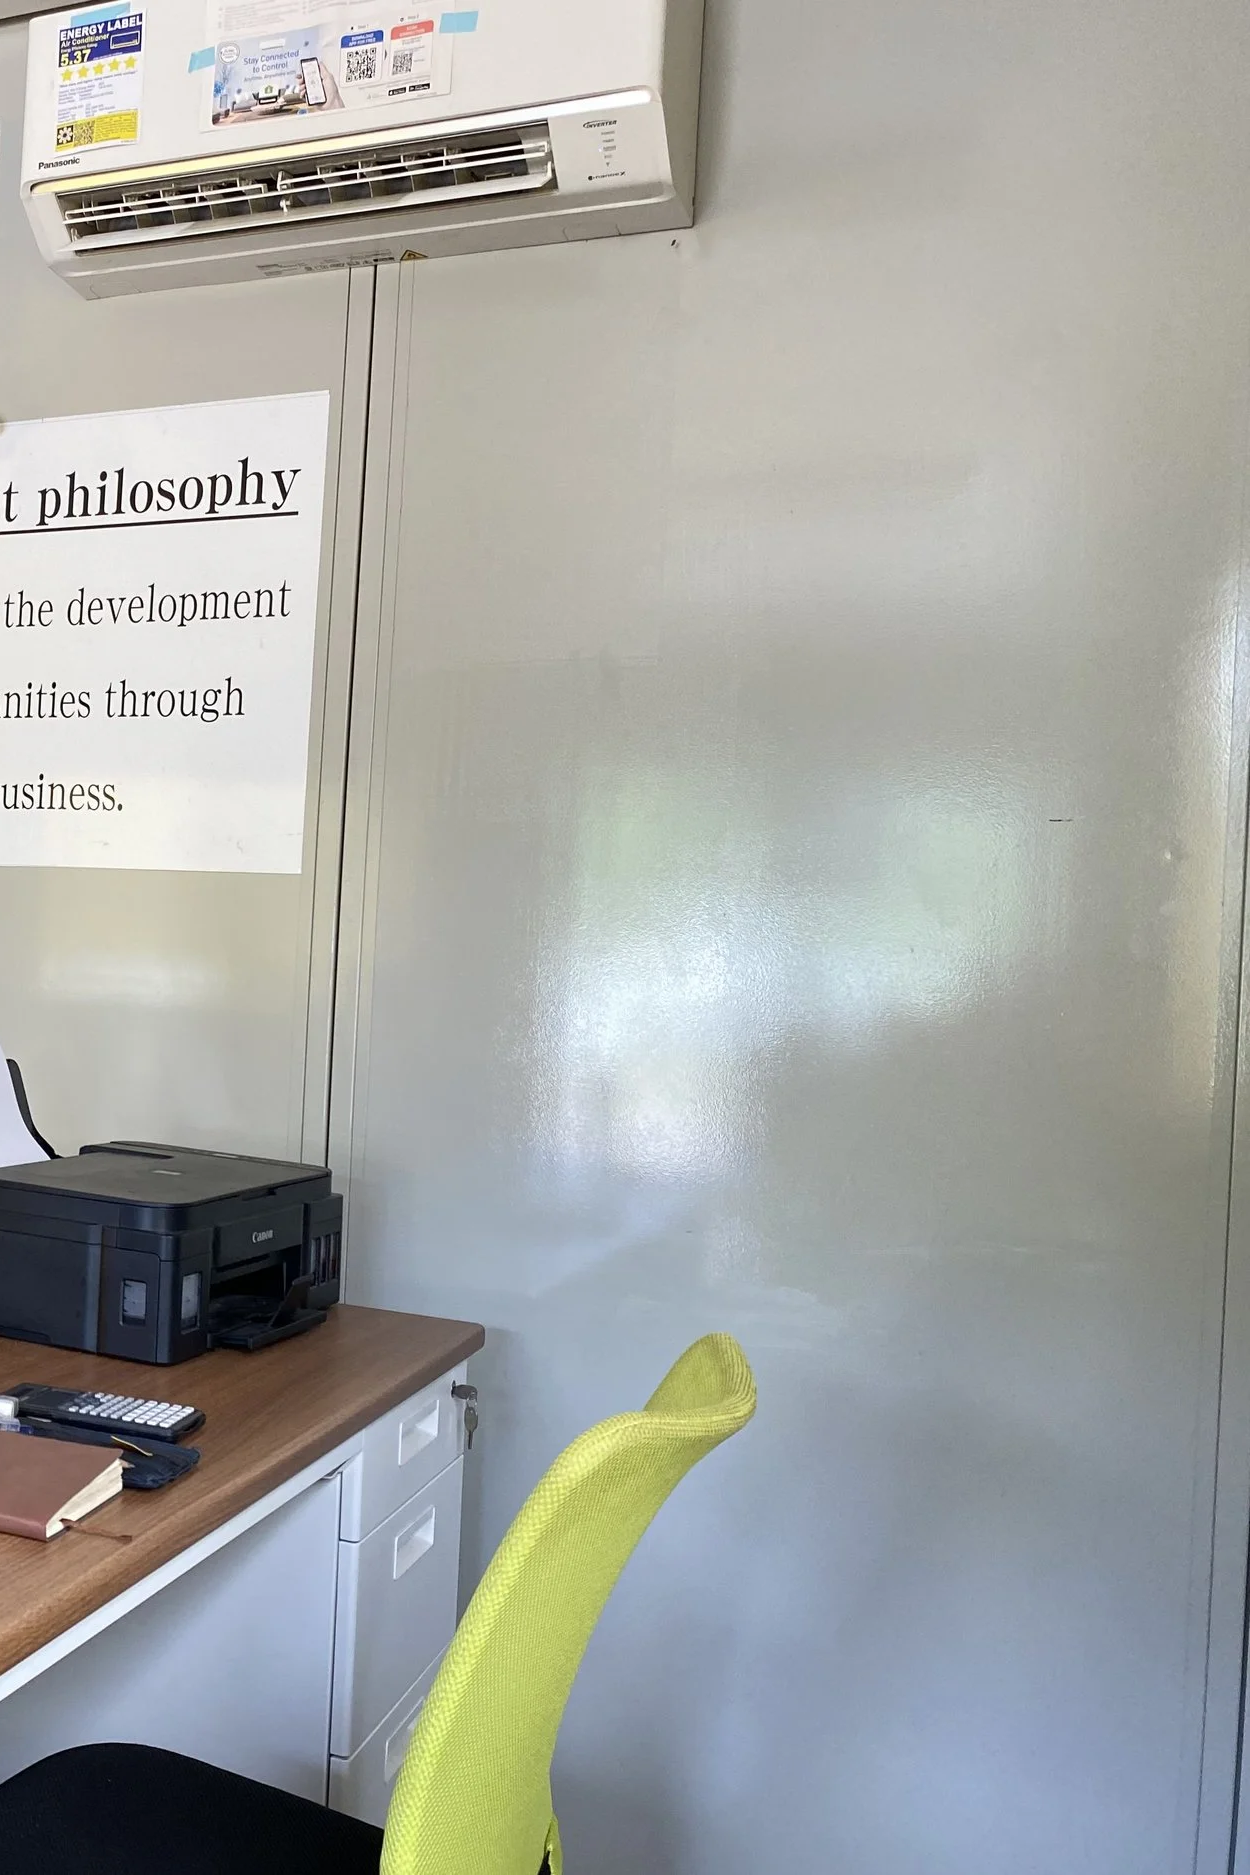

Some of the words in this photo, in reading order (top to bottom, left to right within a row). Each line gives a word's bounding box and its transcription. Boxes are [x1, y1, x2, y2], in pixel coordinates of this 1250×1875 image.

[60, 23, 104, 41] ENERGY
[107, 16, 142, 32] LABEL
[72, 33, 110, 46] Conditioner
[60, 49, 91, 66] 5.37
[243, 58, 259, 66] Stay
[260, 50, 300, 62] Connected
[262, 61, 288, 72] Control
[38, 156, 80, 170] Panasonic
[36, 457, 302, 526] philosophy
[3, 590, 53, 628] the
[66, 579, 292, 627] development
[105, 676, 245, 723] through
[252, 1230, 274, 1243] Canon
